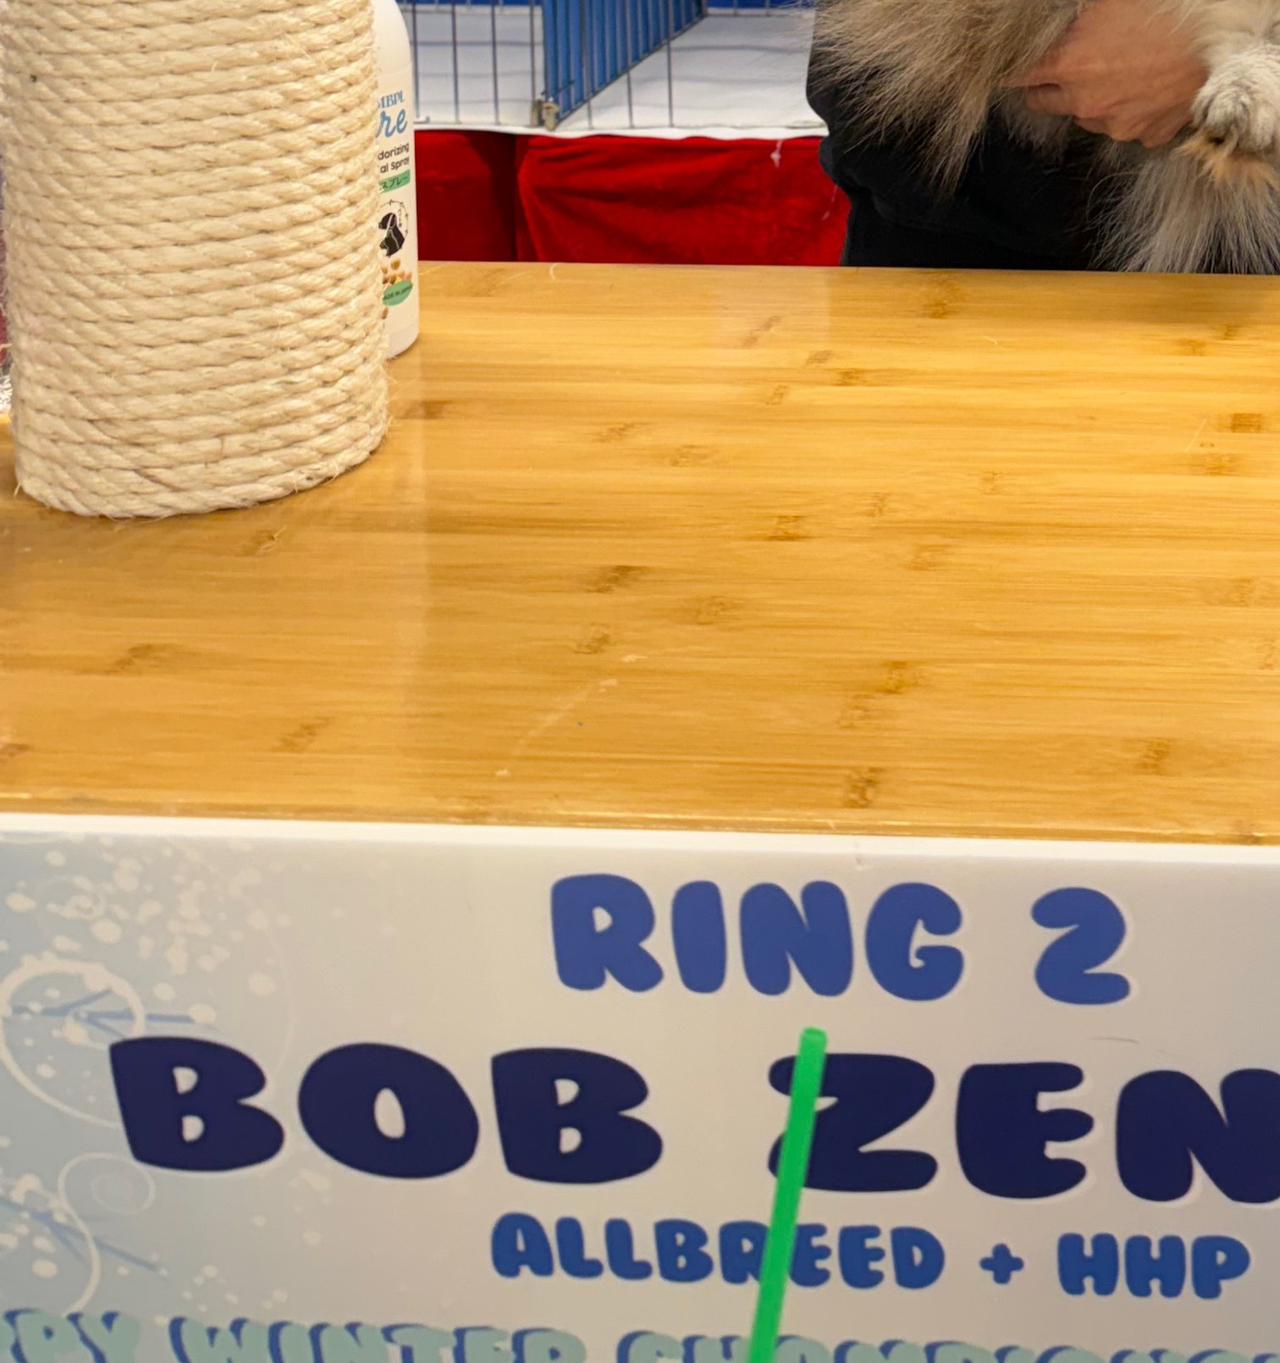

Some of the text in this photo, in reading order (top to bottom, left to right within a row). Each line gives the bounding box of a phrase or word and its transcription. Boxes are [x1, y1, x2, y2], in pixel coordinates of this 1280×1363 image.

[550, 872, 1132, 1006] RING 2
[108, 1035, 664, 1185] BOB
[490, 1211, 1252, 1300] ALLBREED + HHP
